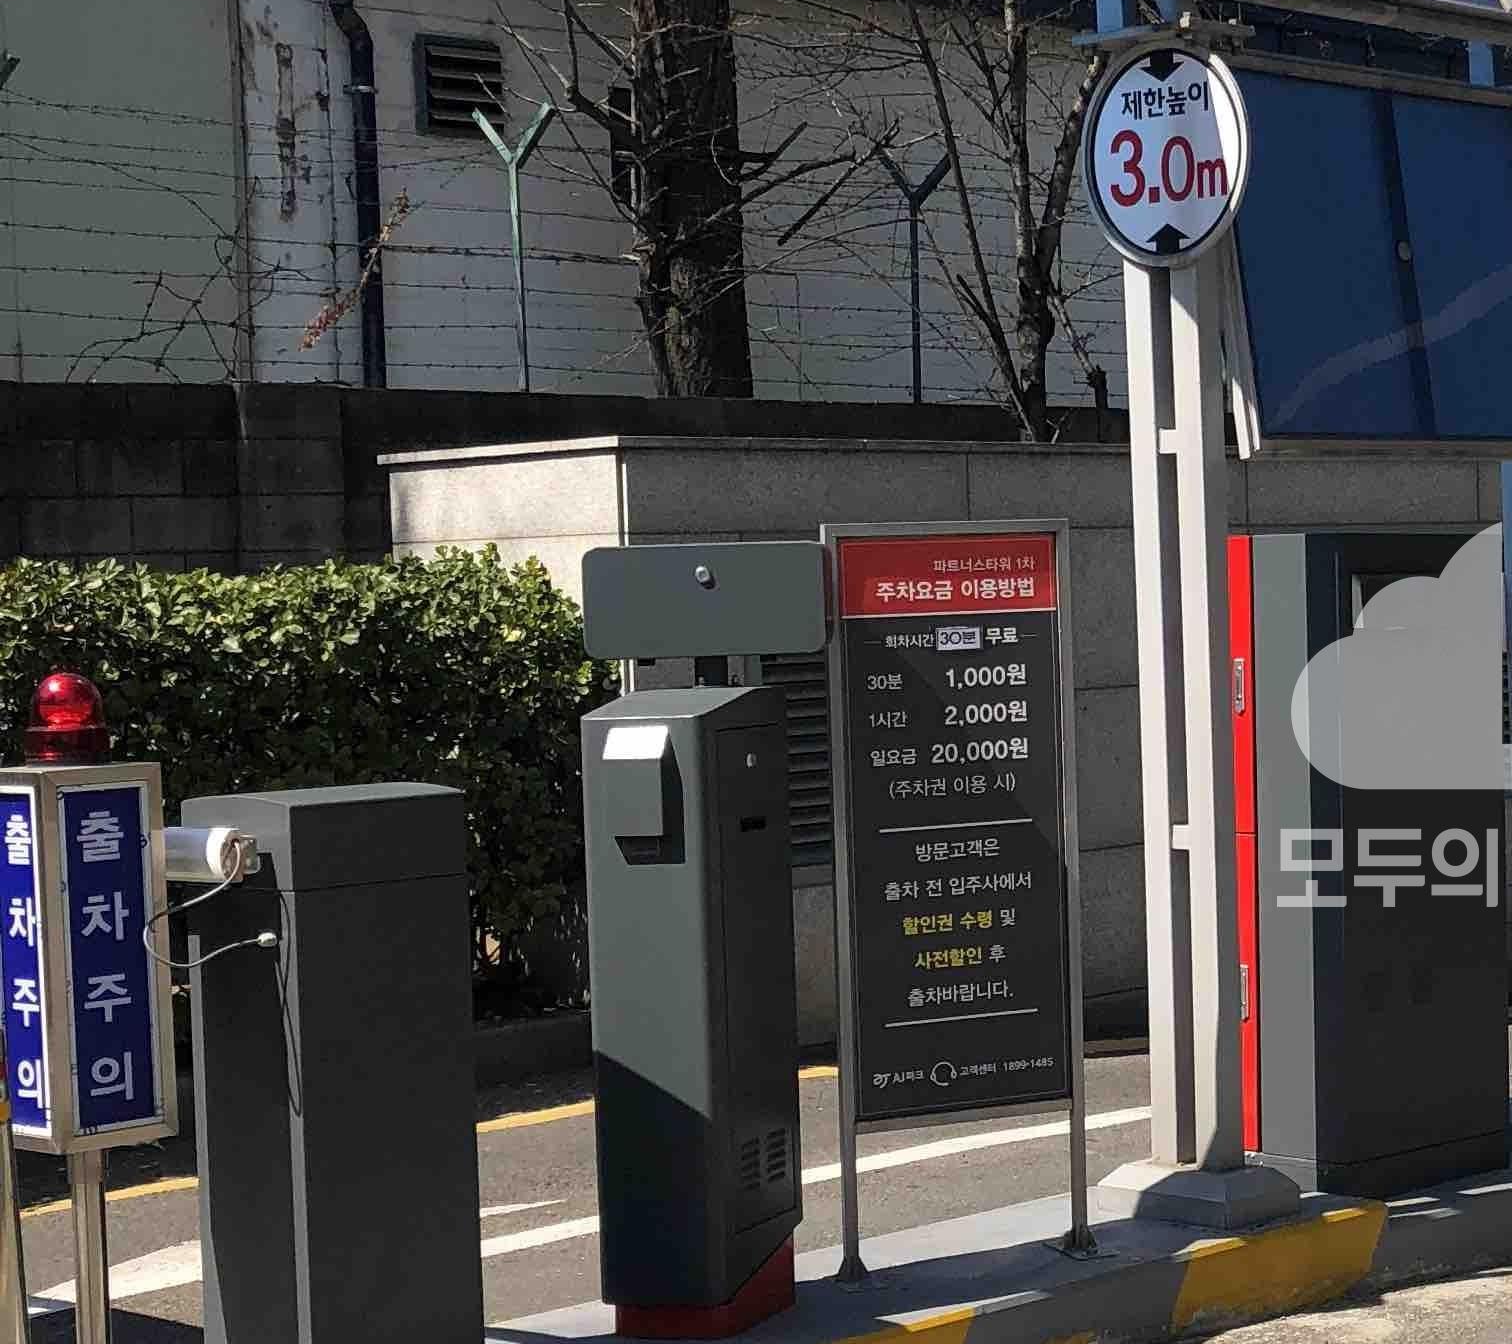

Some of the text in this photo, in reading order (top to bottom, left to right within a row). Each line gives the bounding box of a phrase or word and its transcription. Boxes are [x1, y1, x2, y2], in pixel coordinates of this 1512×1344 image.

[1121, 80, 1209, 121] 제한높이
[1110, 129, 1229, 207] 3.0m
[875, 576, 1035, 603] 주차요금 이용방법
[985, 626, 1019, 646] 무료
[867, 663, 1027, 690] 30분 1,000원
[868, 700, 1028, 729] 1시간 2,000원
[930, 737, 1029, 765] 20,000원
[889, 771, 1016, 799] (주차권 이용 시)
[915, 837, 1001, 862] 방문고객은
[884, 871, 1032, 901] 출차 전 입주사에서
[903, 913, 953, 935] 할인권
[1000, 908, 1016, 927] 및
[5, 813, 45, 1111] 출차주의
[76, 810, 135, 1102] 출차주의
[914, 944, 1006, 969] 사전할인 후
[908, 979, 1014, 1007] 출차바랍니다.
